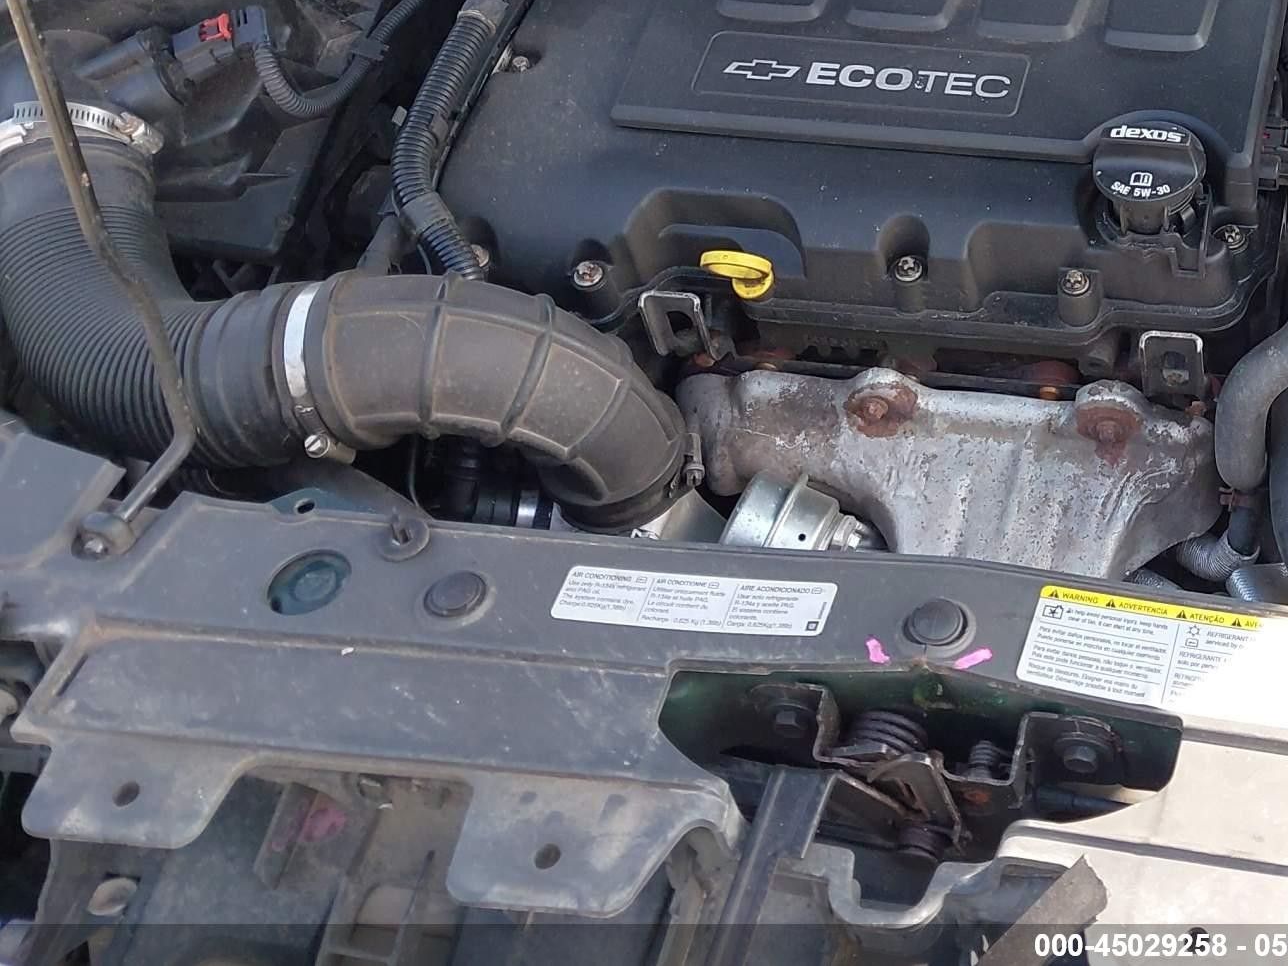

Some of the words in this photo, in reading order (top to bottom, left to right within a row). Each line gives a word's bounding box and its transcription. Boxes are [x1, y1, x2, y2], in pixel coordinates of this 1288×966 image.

[1110, 125, 1186, 143] dexos
[1111, 181, 1132, 195] SAE
[1133, 184, 1171, 197] 5W-30
[584, 573, 632, 581] CONDITIONING
[757, 585, 810, 594] ACONDICIONADO
[1062, 593, 1098, 603] WARNING
[1119, 602, 1167, 615] ADVERTENCIA
[1190, 613, 1225, 624] ATENÇÃO
